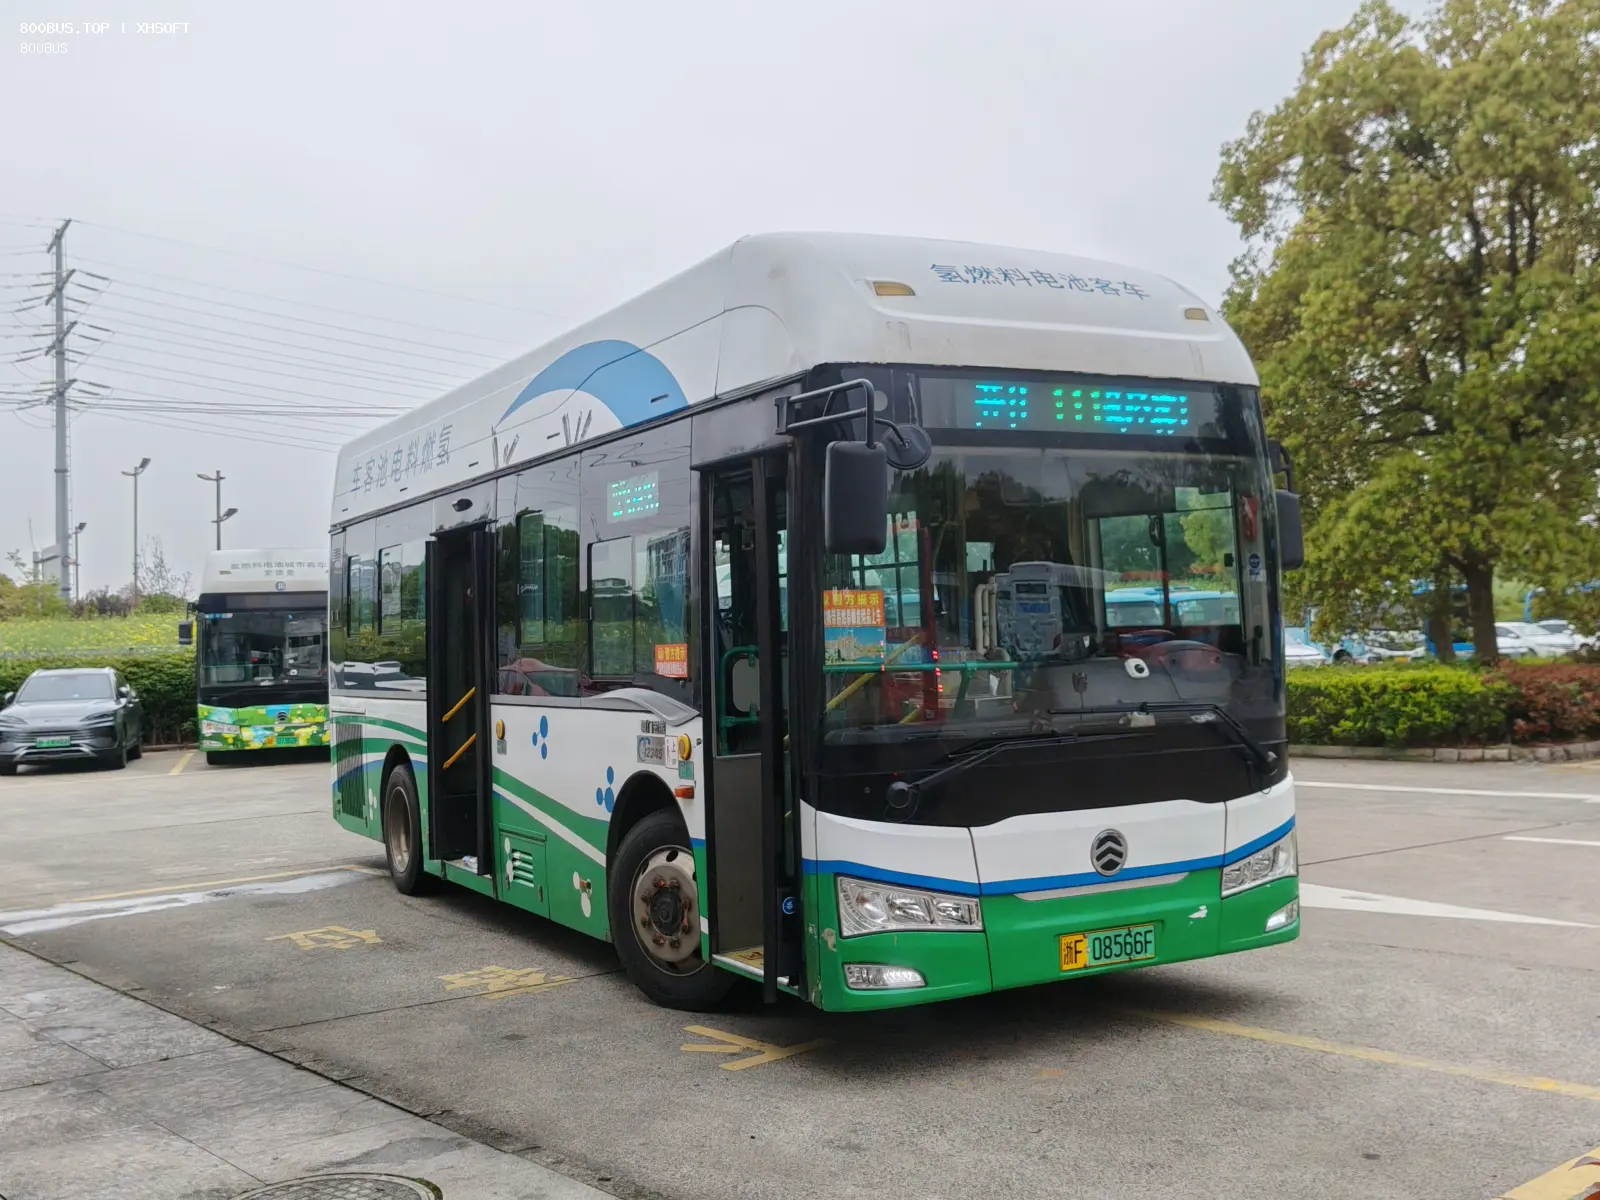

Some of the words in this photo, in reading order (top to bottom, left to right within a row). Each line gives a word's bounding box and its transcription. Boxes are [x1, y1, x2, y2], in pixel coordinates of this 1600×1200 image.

[930, 263, 1150, 300] 氢燃料电池客车
[1092, 929, 1153, 961] 08566F
